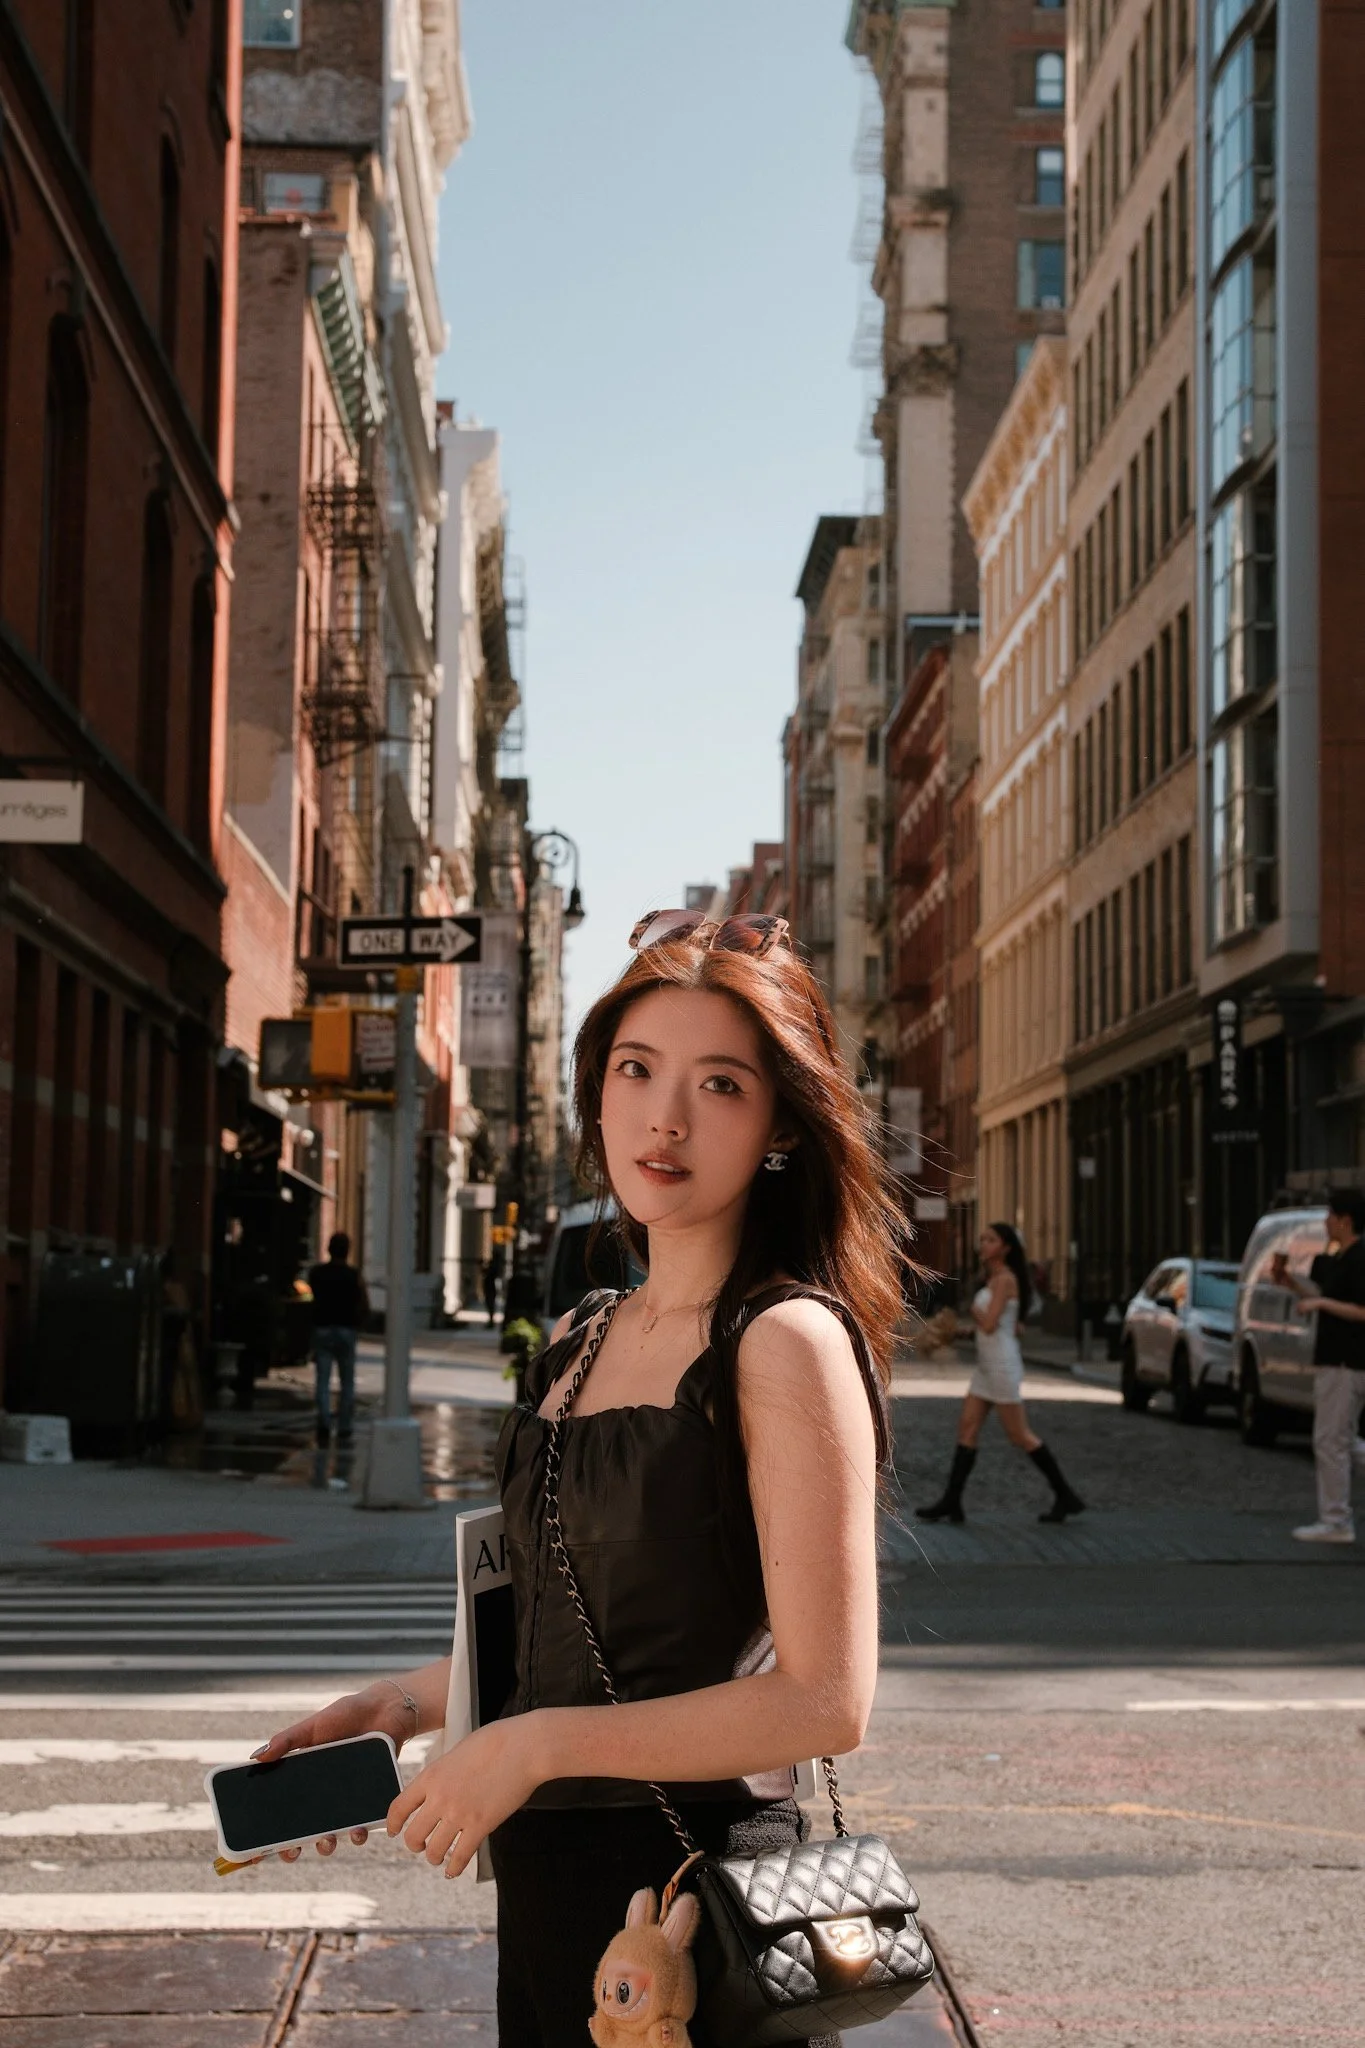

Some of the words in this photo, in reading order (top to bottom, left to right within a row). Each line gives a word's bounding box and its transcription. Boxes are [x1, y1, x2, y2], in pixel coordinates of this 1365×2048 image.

[359, 933, 399, 950] ONE
[419, 931, 460, 949] WAY
[1219, 1024, 1237, 1091] PARK
